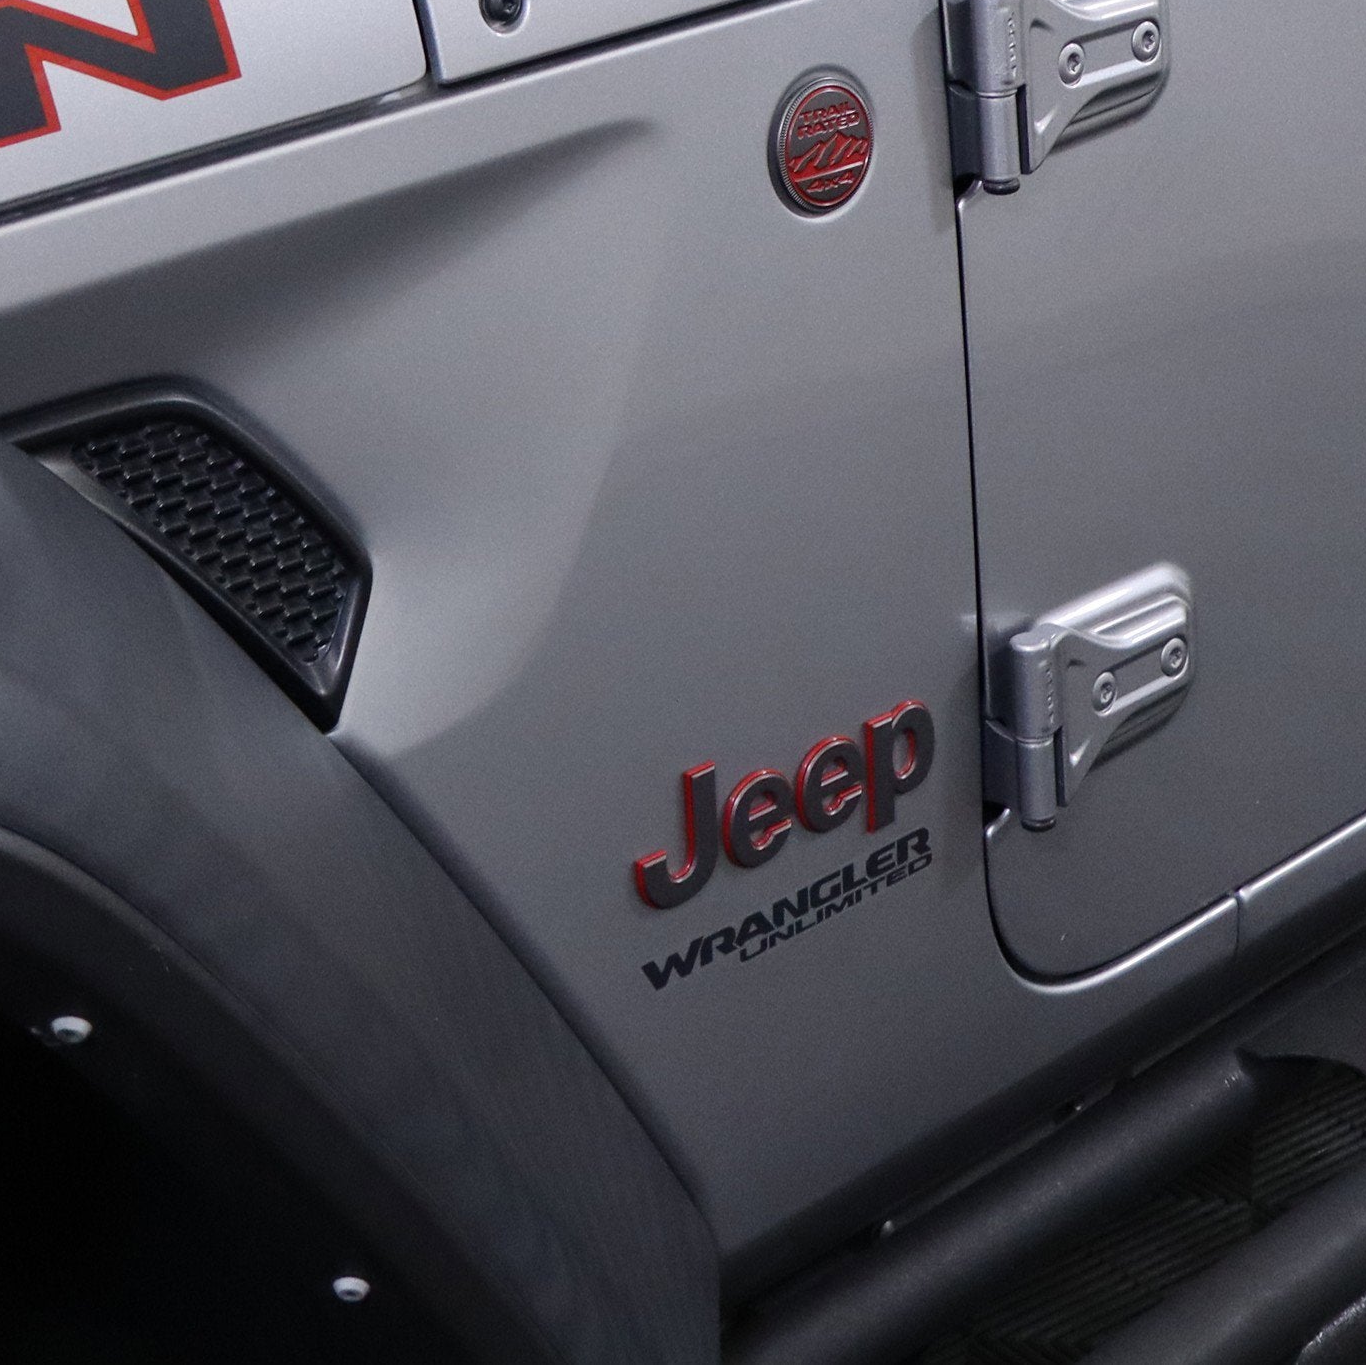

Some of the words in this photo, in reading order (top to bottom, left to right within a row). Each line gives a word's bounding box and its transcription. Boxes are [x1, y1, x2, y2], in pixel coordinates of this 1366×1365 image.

[797, 112, 861, 140] RATED
[798, 101, 856, 124] TRAIL
[635, 699, 936, 910] Jeep
[641, 827, 933, 991] WRANGLER
[739, 852, 933, 963] UNLIMITED
